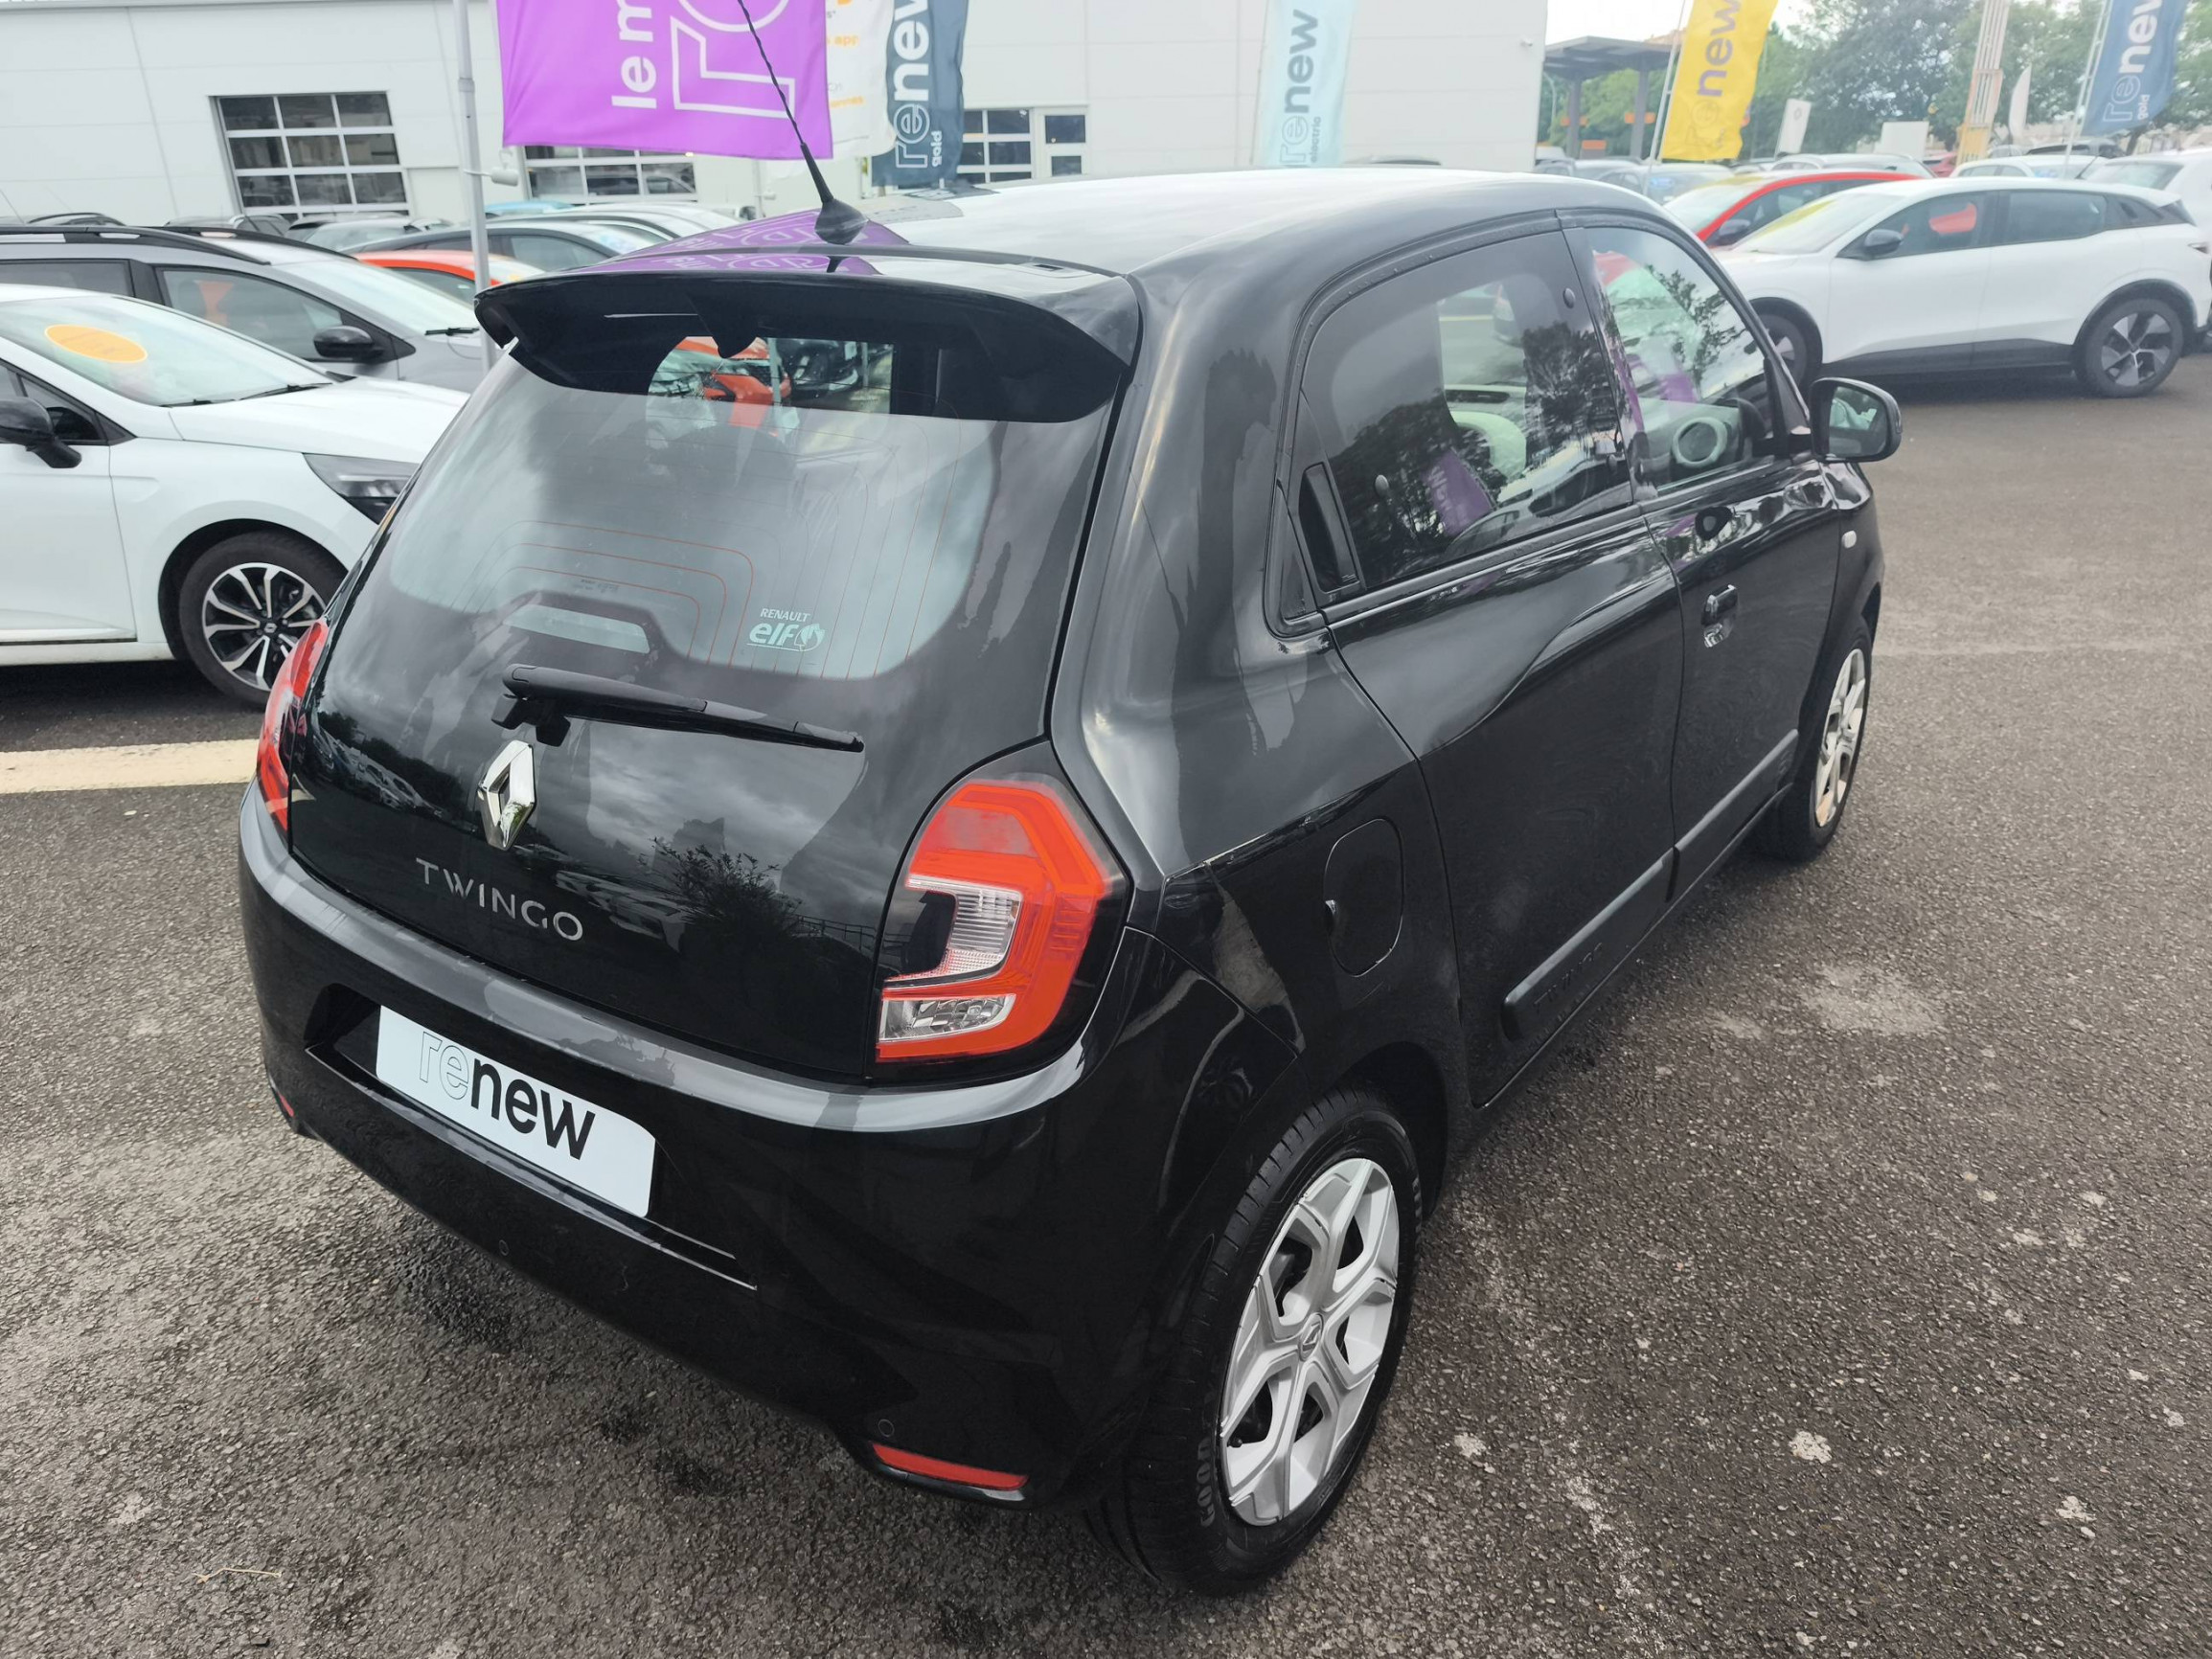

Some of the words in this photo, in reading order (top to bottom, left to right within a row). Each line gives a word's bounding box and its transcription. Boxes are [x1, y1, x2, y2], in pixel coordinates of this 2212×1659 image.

[1279, 9, 1319, 164] renew
[2137, 94, 2151, 121] gold
[930, 130, 943, 168] gold
[1309, 116, 1322, 164] electric
[749, 622, 800, 647] elf
[760, 606, 811, 623] RENAULT
[415, 856, 584, 941] TWINGO
[419, 1031, 596, 1161] renew
